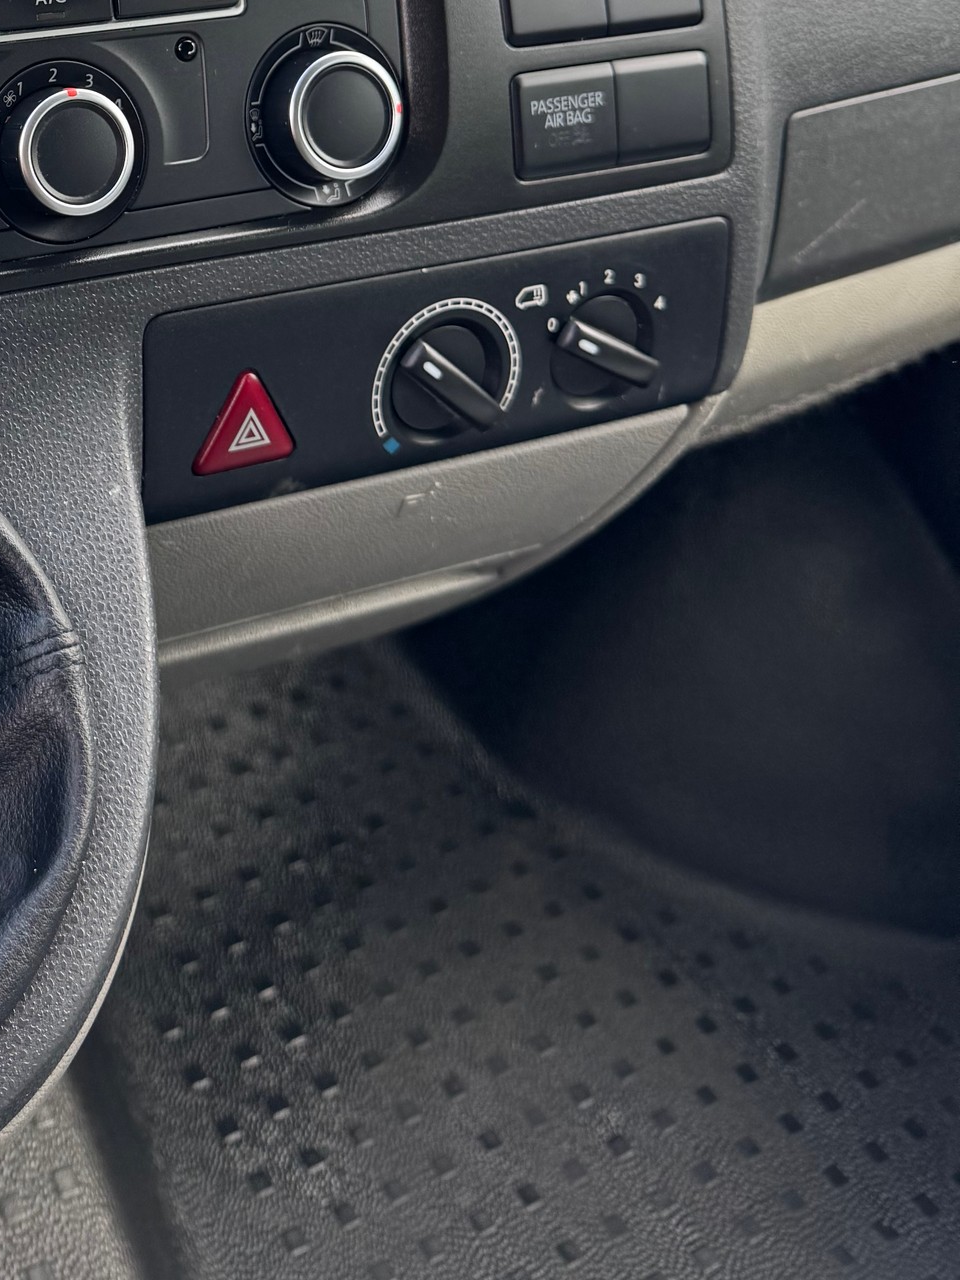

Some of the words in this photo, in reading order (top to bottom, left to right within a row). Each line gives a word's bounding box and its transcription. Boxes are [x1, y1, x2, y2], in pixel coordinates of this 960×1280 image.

[17, 81, 23, 96] 1
[48, 68, 58, 83] 2
[85, 74, 94, 88] 3
[530, 91, 604, 116] PASSENGER
[544, 114, 565, 129] AIR
[566, 108, 592, 126] BAG
[578, 281, 588, 297] 1
[603, 268, 616, 285] 2
[633, 272, 646, 289] 3
[653, 295, 666, 311] 4
